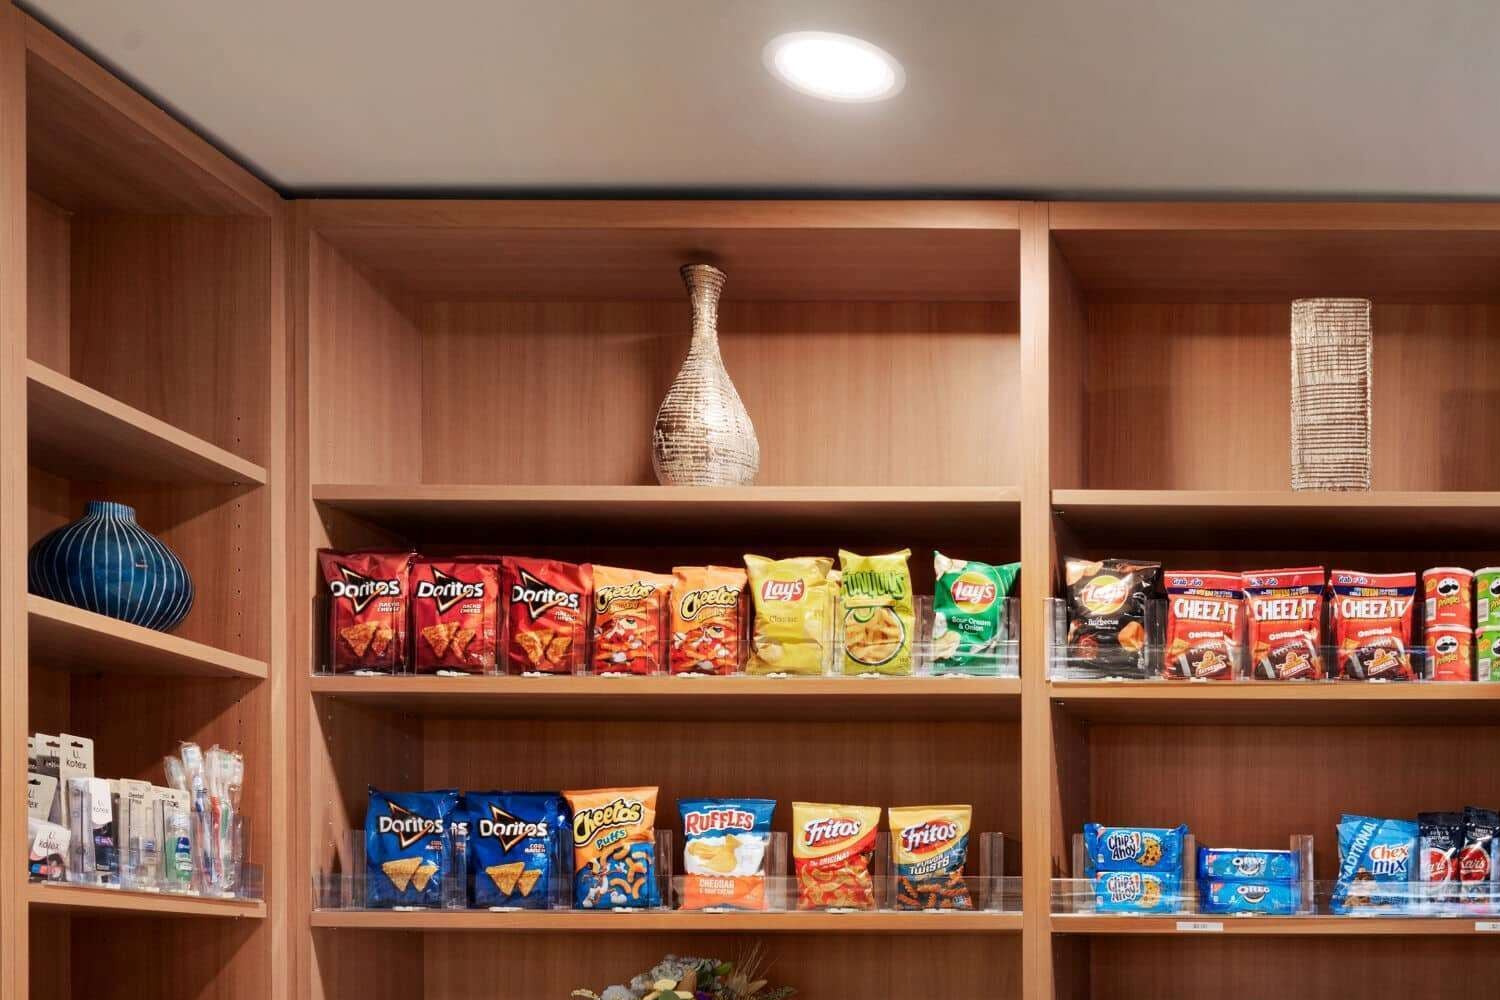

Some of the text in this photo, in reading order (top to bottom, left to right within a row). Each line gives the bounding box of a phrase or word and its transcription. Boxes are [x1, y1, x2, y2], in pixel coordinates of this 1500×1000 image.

[331, 580, 399, 598] Doritos
[418, 580, 483, 598] Doritos
[512, 585, 579, 607] Doritos
[596, 582, 655, 614] Cheetos
[764, 579, 803, 600] Lay's
[955, 581, 994, 603] Lay's
[681, 586, 738, 620] Cheetos
[379, 817, 443, 833] Doritos
[480, 819, 547, 838] Doritos
[574, 799, 643, 846] Cheetos
[685, 810, 754, 835] RUFFLES
[805, 819, 862, 846] Fritos
[596, 829, 626, 849] Puffs
[901, 823, 956, 851] Fritos
[1108, 834, 1134, 849] Chips
[1371, 845, 1408, 861] Chex
